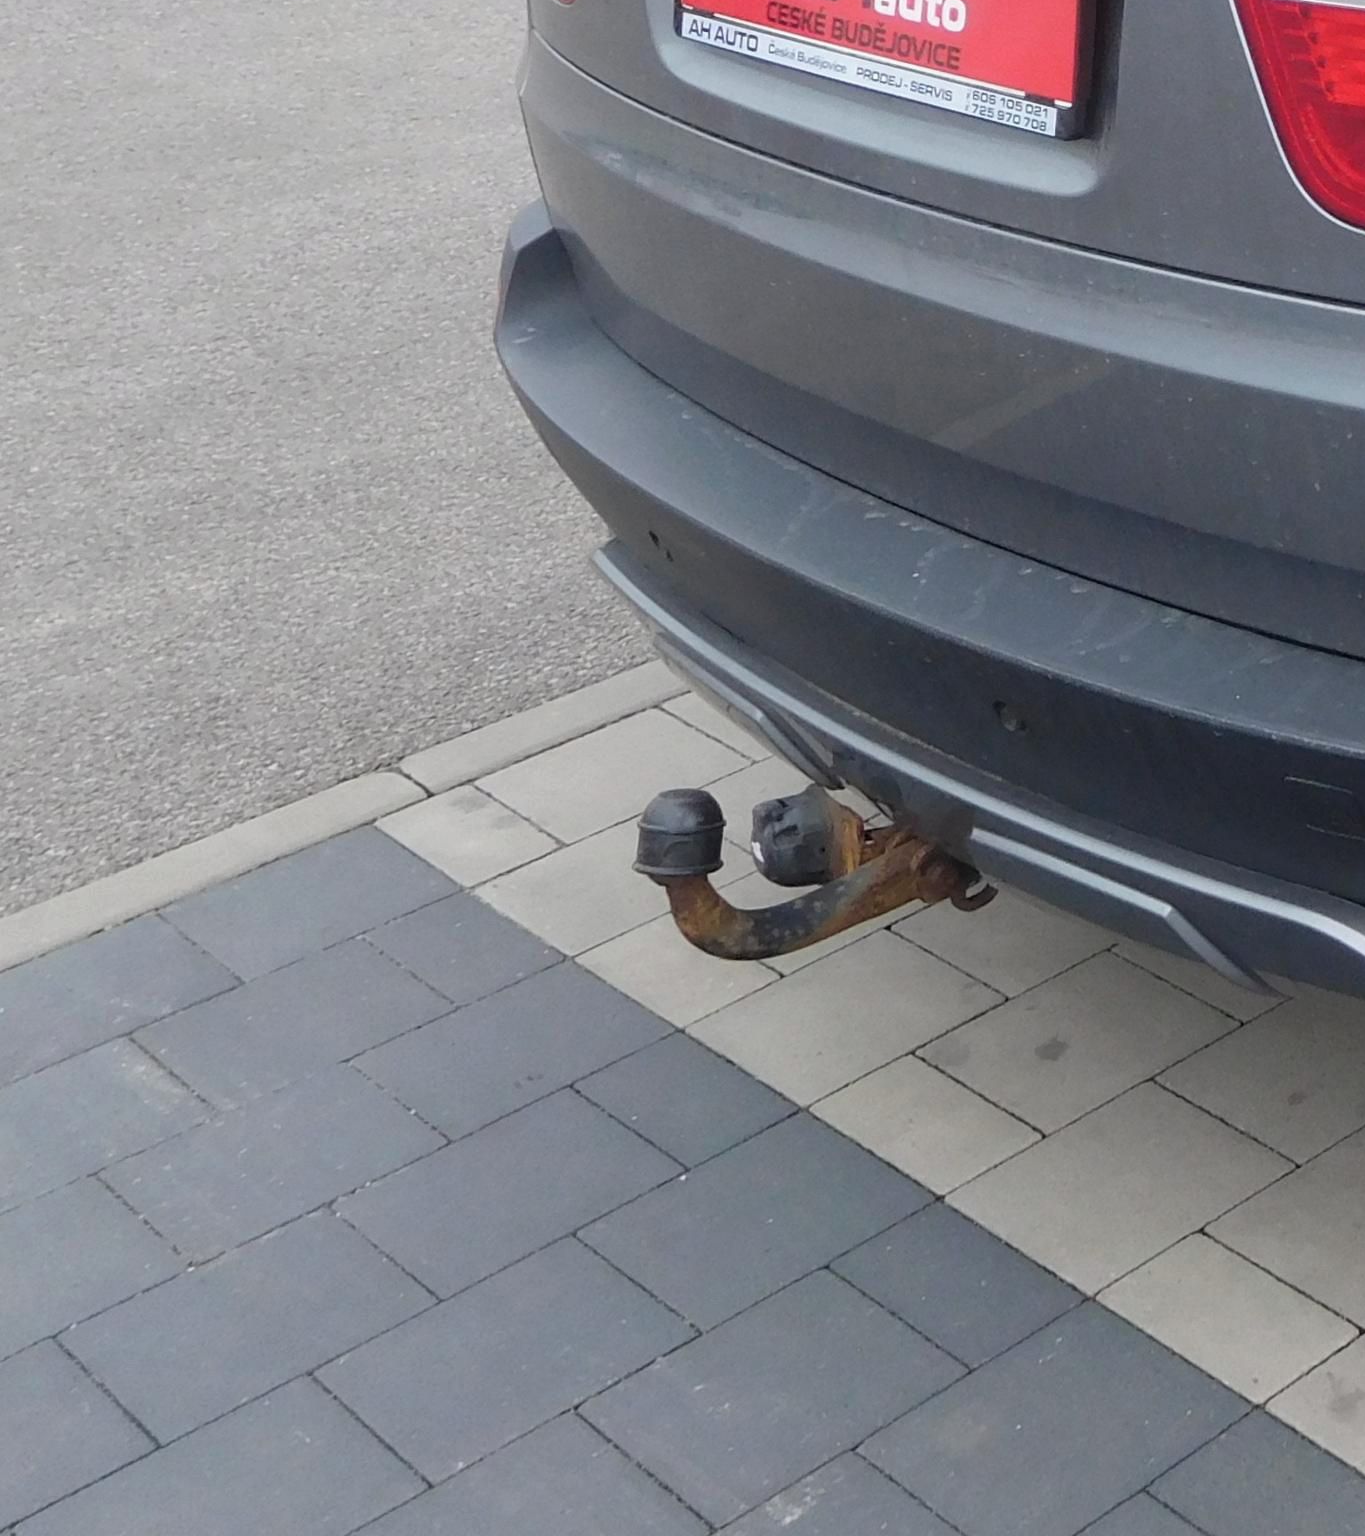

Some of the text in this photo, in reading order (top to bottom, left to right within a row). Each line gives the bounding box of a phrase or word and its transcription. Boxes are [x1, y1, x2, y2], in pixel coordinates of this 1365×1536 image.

[688, 18, 711, 41] AH
[714, 26, 759, 53] AUTO
[856, 67, 903, 88] PRODEJ
[910, 80, 954, 101] SERVIS
[831, 17, 962, 71] BUDĚJOVICE
[972, 104, 994, 118] 725
[997, 110, 1021, 125] 970
[1024, 117, 1047, 132] 708
[1000, 97, 1023, 112] 105
[1025, 103, 1048, 117] 021
